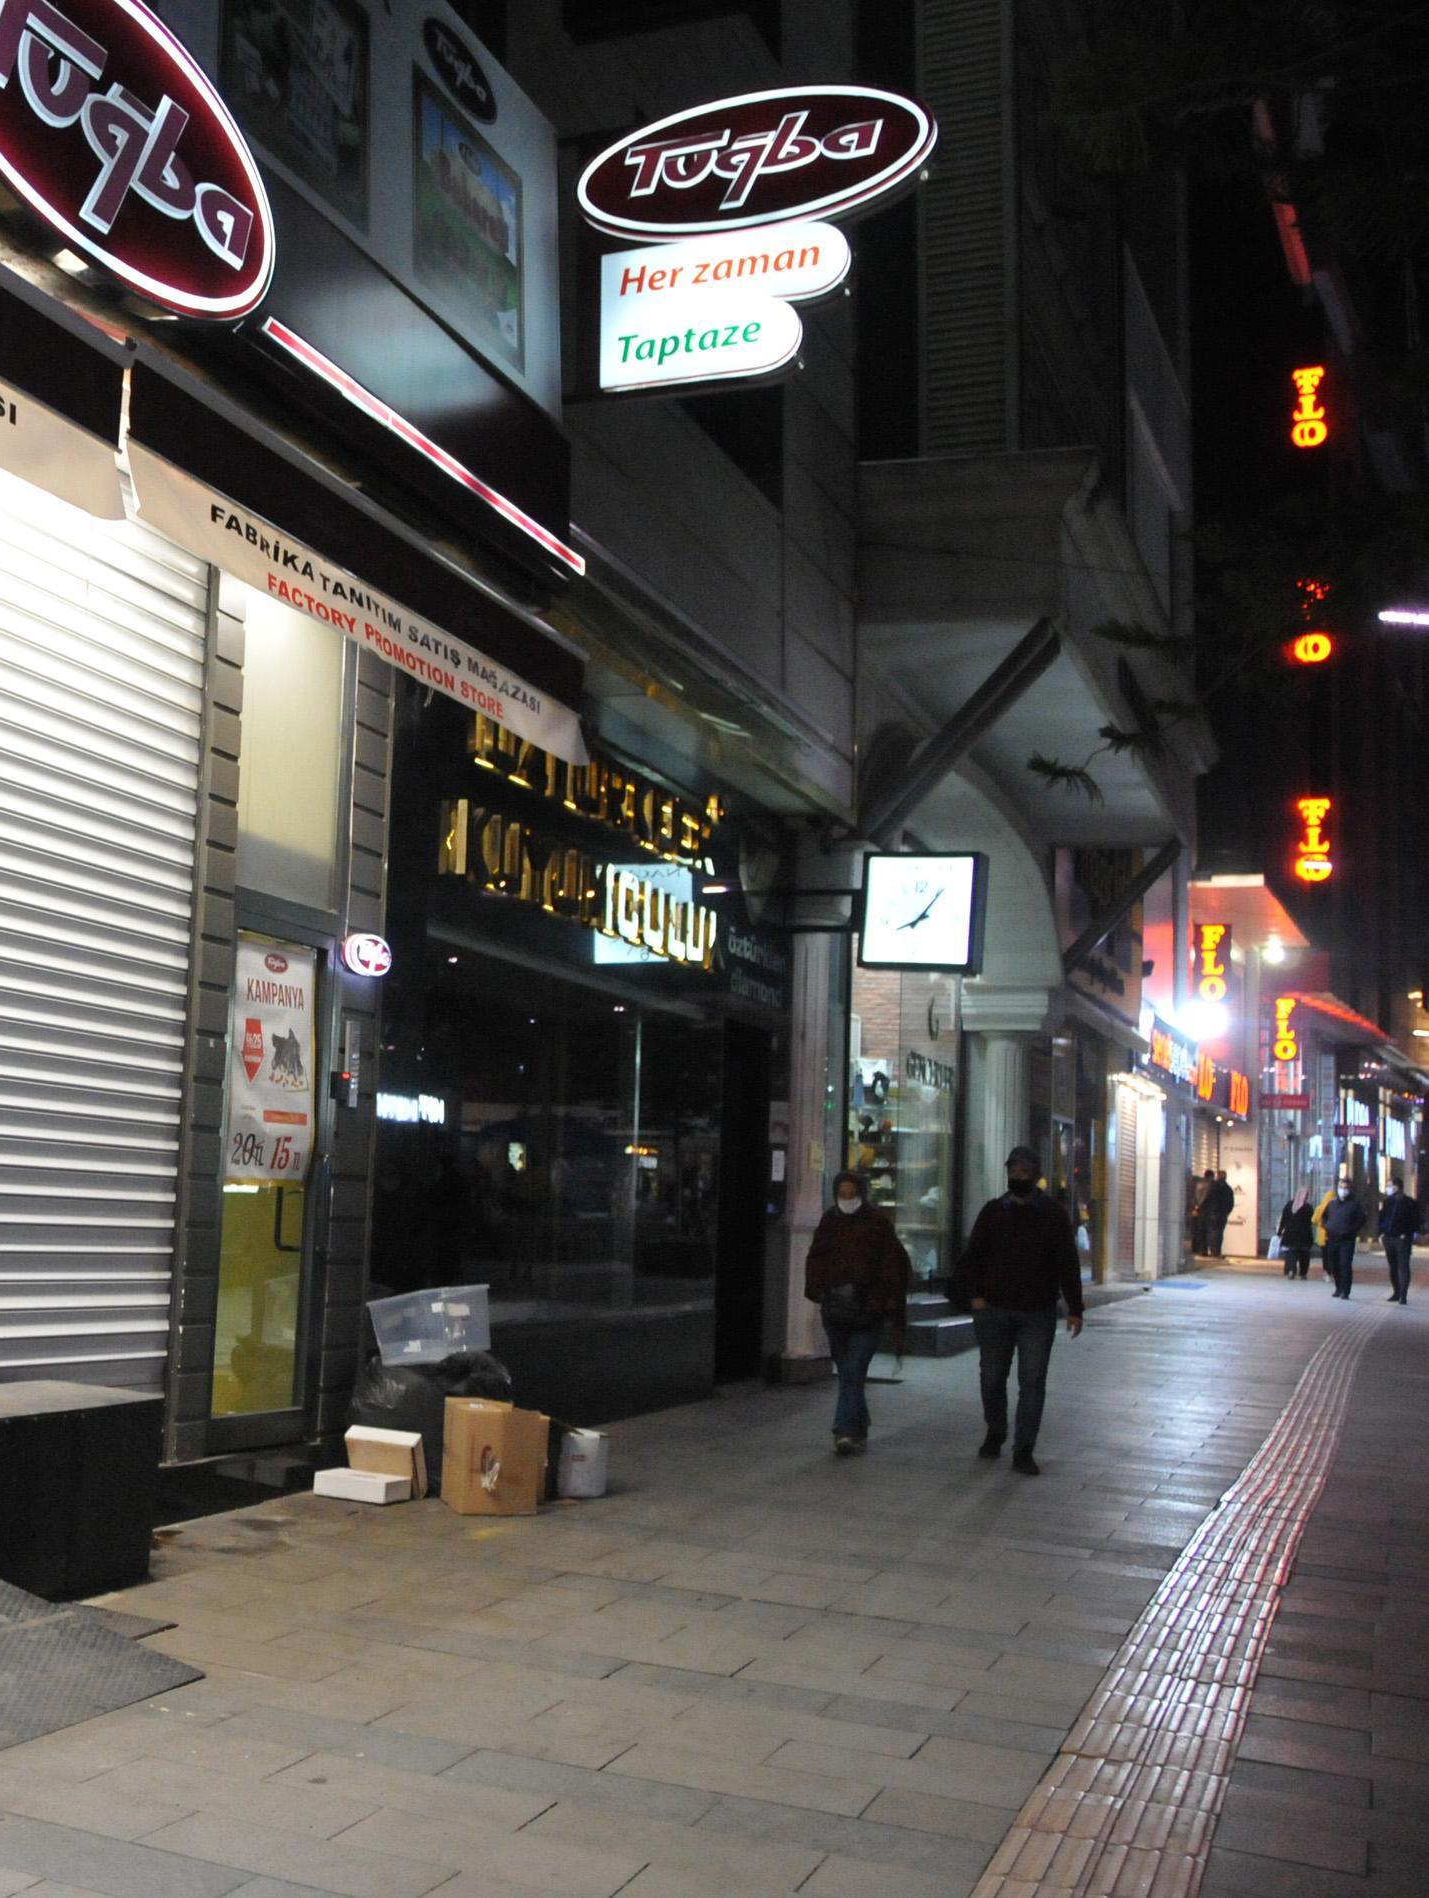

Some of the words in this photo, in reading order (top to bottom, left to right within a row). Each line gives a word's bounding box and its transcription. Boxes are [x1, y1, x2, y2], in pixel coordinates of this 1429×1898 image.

[619, 265, 682, 297] Her
[692, 244, 821, 285] zaman
[616, 319, 763, 365] Taptaze
[210, 503, 316, 582] FABRİKA
[319, 569, 402, 635] TANITIM
[407, 625, 462, 668] SATIŞ
[467, 656, 542, 717] MAĞAZASI
[267, 571, 357, 635] FACTORY
[364, 623, 455, 691] PROMOTION
[460, 681, 506, 720] STORE
[1199, 924, 1227, 1002] FLO
[246, 977, 305, 1011] KAMPANYA
[1274, 997, 1298, 1061] FLO
[270, 1136, 292, 1170] 15
